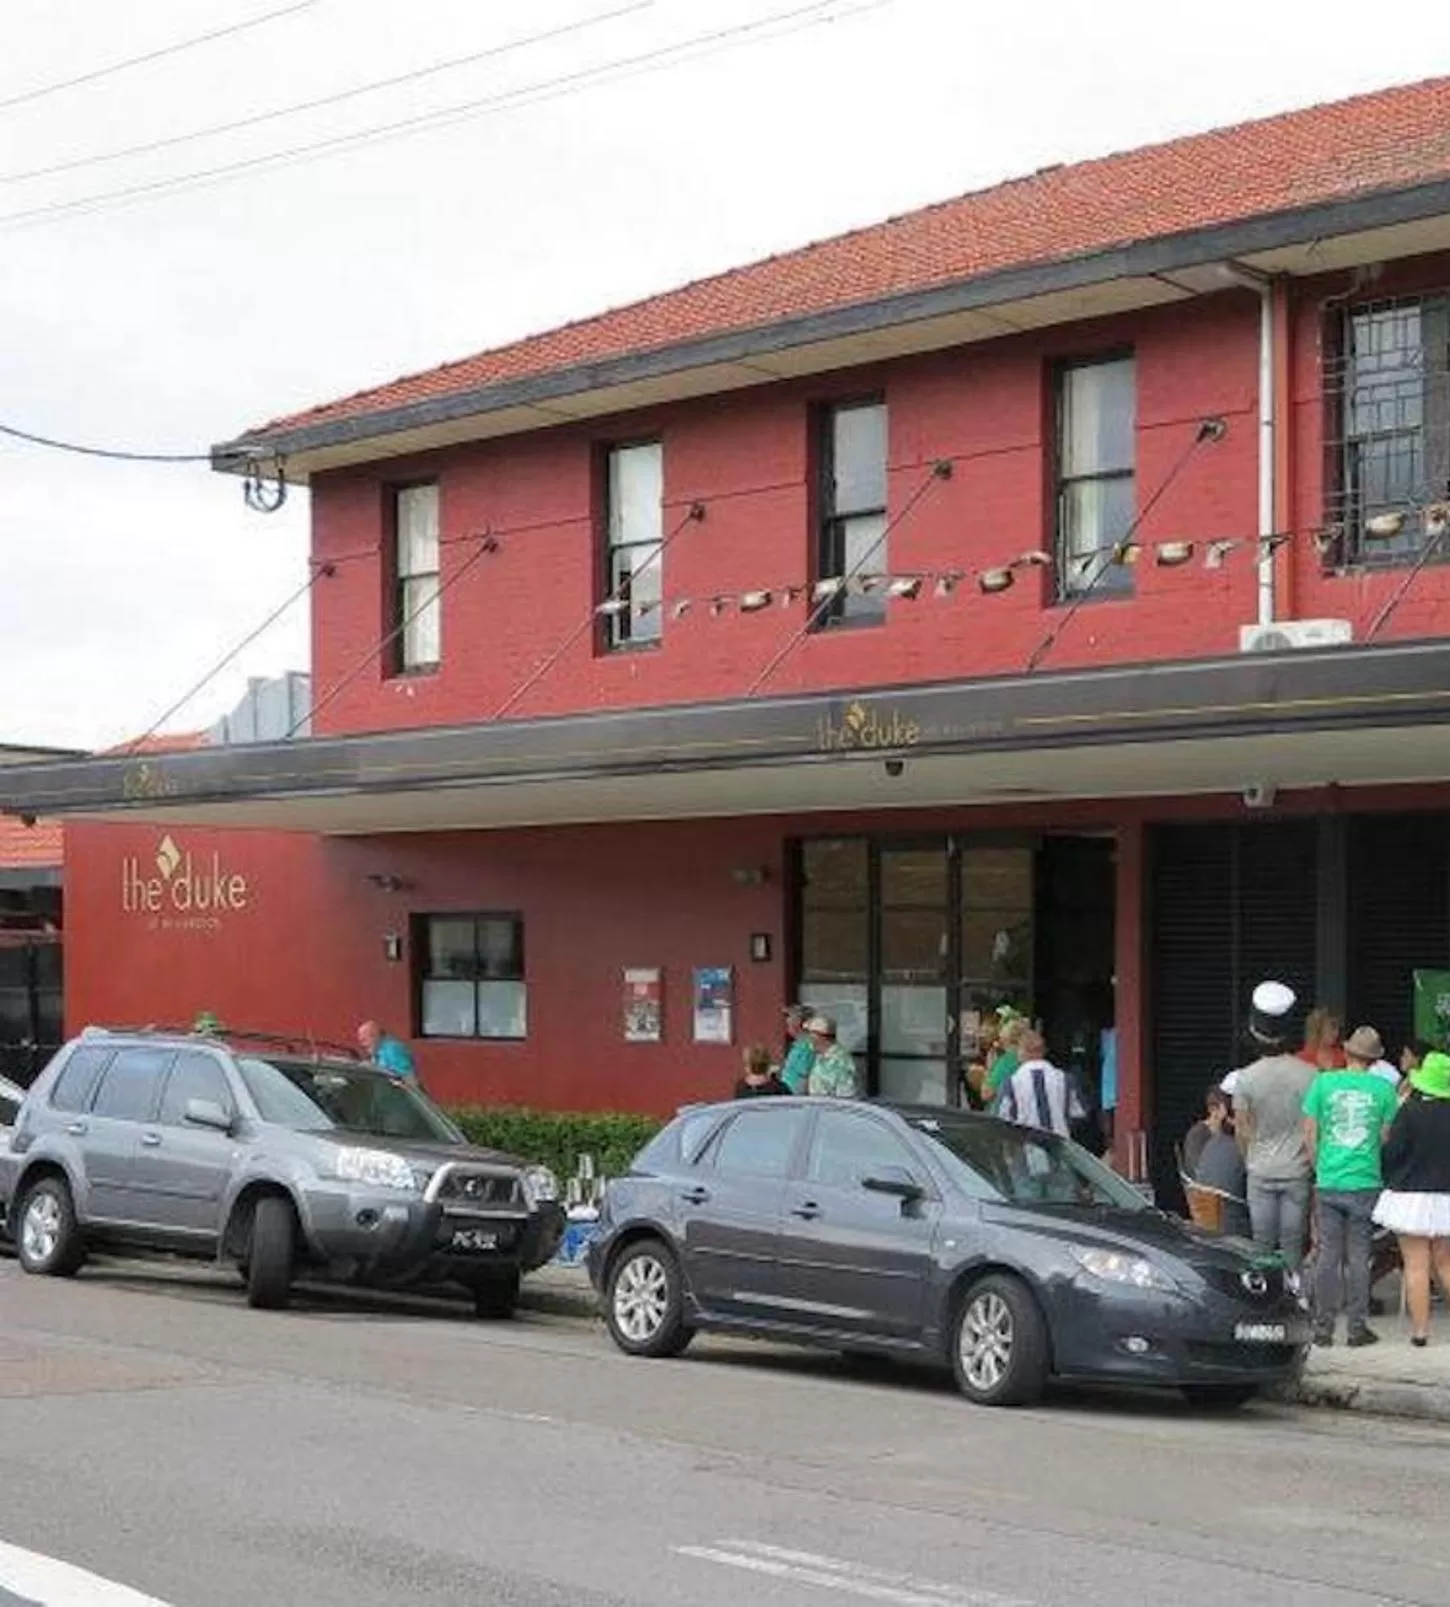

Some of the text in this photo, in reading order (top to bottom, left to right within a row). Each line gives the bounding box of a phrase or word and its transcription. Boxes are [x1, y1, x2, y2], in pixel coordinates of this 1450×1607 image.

[860, 708, 920, 746] duke
[122, 851, 246, 912] the duke
